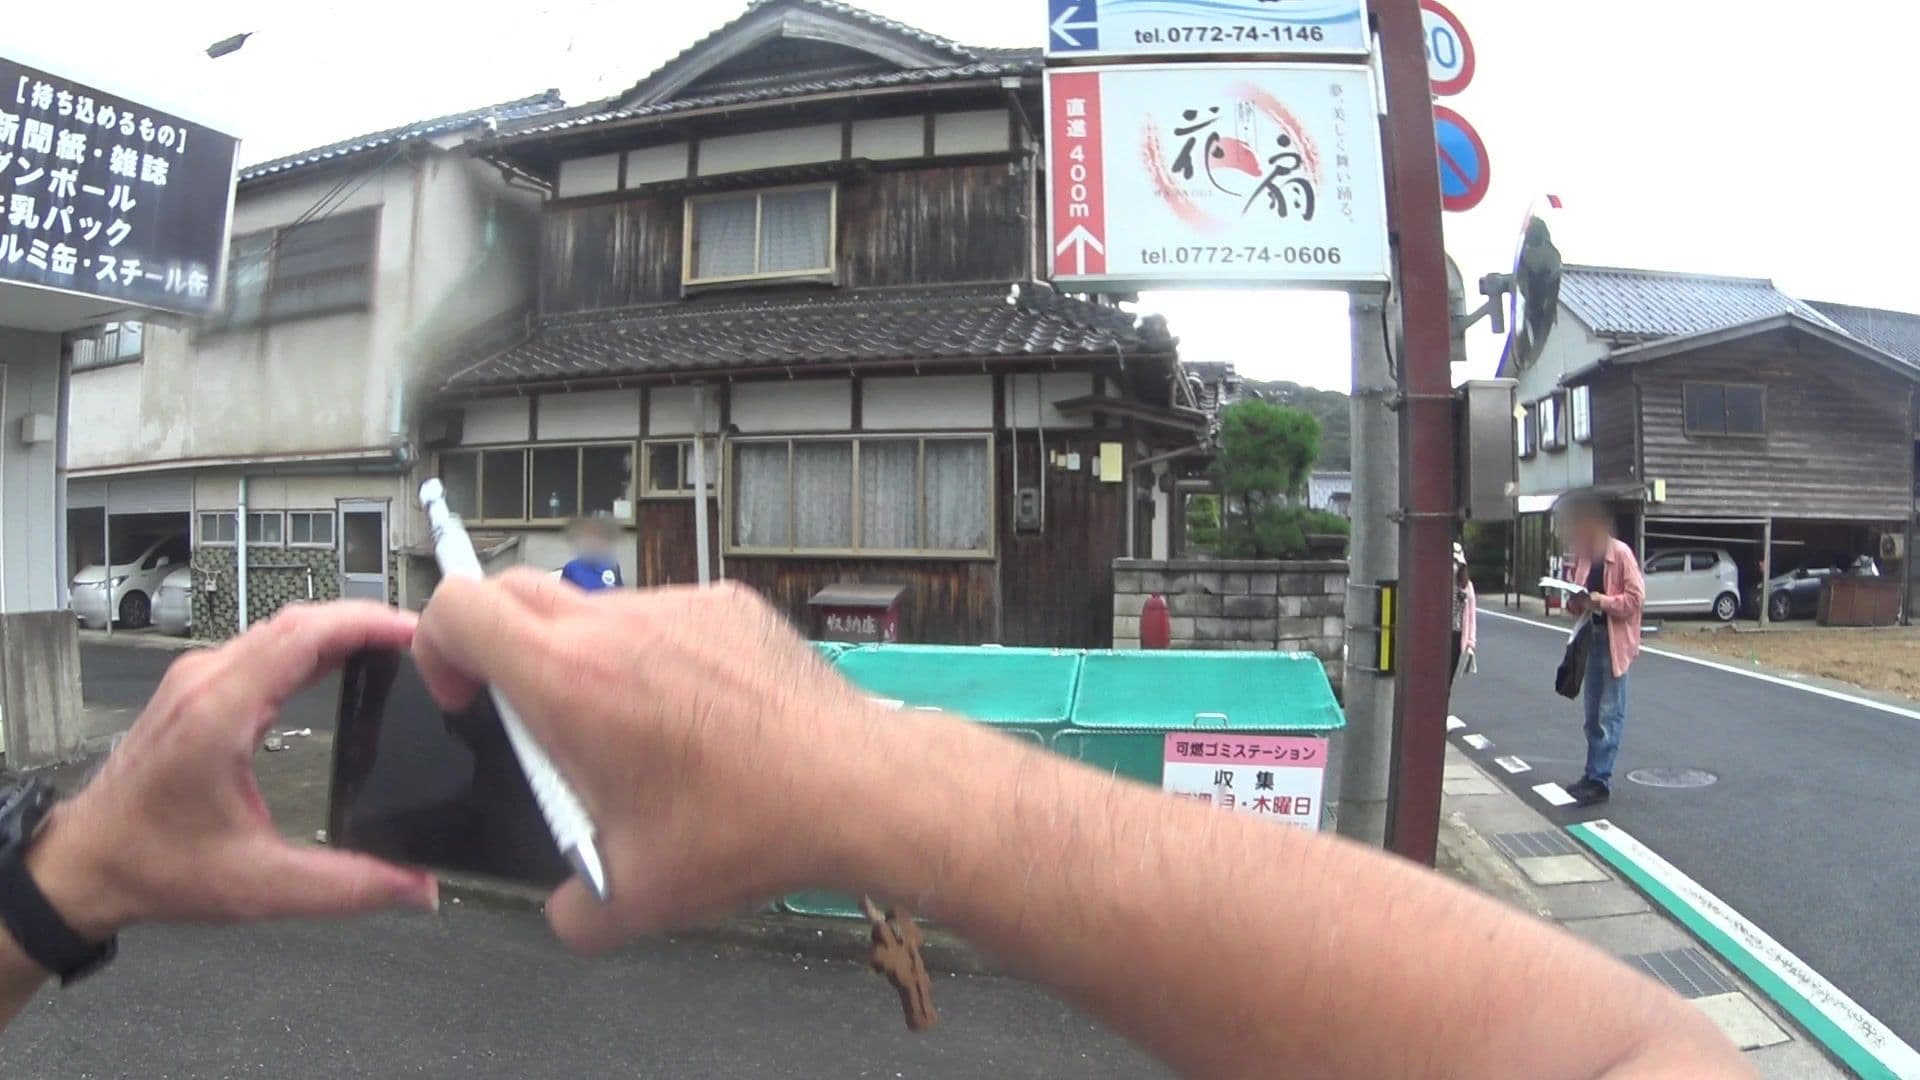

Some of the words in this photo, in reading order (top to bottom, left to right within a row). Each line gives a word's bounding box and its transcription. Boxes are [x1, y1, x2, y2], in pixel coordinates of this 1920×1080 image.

[1134, 25, 1325, 44] tel.0772-74-1146
[1424, 26, 1456, 69] 0
[1065, 98, 1089, 217] 直進400m
[1171, 105, 1316, 222] 花扇
[0, 193, 132, 248] 乳パック
[1141, 246, 1342, 265] tel.0772-74-0606
[1175, 741, 1317, 761] 可燃ゴミステーション
